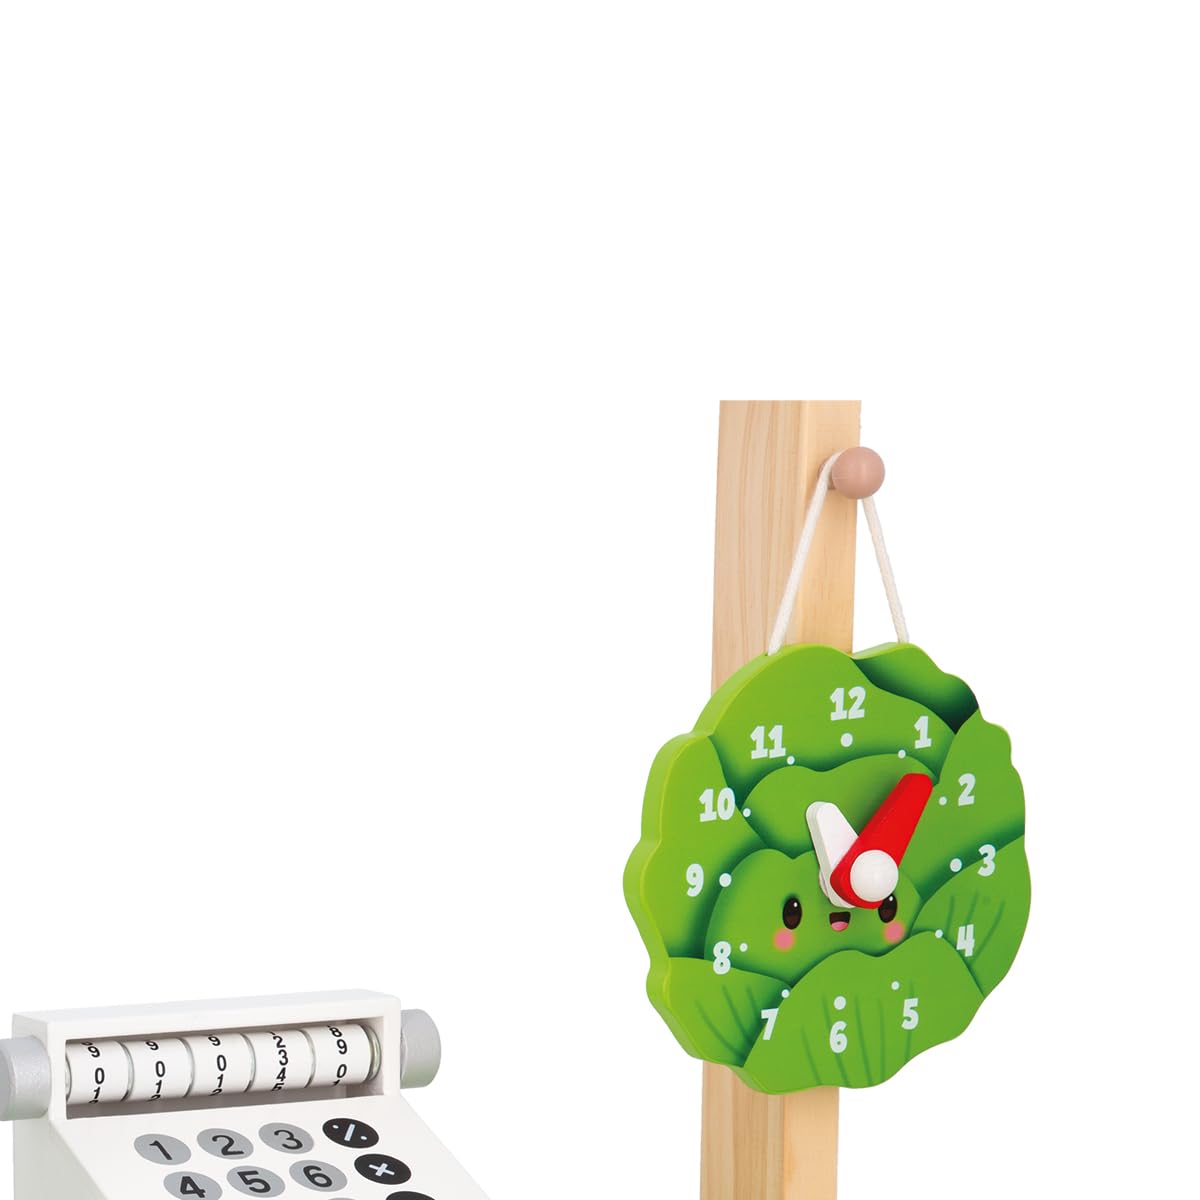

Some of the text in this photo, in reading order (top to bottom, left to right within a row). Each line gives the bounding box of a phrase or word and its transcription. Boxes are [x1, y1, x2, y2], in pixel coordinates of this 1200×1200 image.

[830, 685, 866, 721] 12
[750, 724, 787, 760] 11
[914, 715, 932, 749] 1
[698, 787, 736, 823] 10
[958, 773, 976, 806] 2
[977, 844, 997, 877] 3
[685, 863, 705, 897] 9
[956, 923, 975, 957] 4
[712, 940, 732, 975] 8
[761, 1007, 780, 1041] 7
[901, 997, 919, 1030] 5
[829, 1020, 848, 1054] 6
[94, 1038, 348, 1085] 0 0 0 3 9
[155, 1079, 163, 1094] 1
[216, 1073, 224, 1088] 1
[276, 1067, 287, 1082] 4
[336, 1063, 347, 1079] 0
[149, 1140, 173, 1161] 1
[211, 1134, 245, 1156] 2
[274, 1129, 303, 1150] 3
[180, 1176, 206, 1198] 4
[237, 1170, 271, 1193] 5
[303, 1165, 333, 1188] 6
